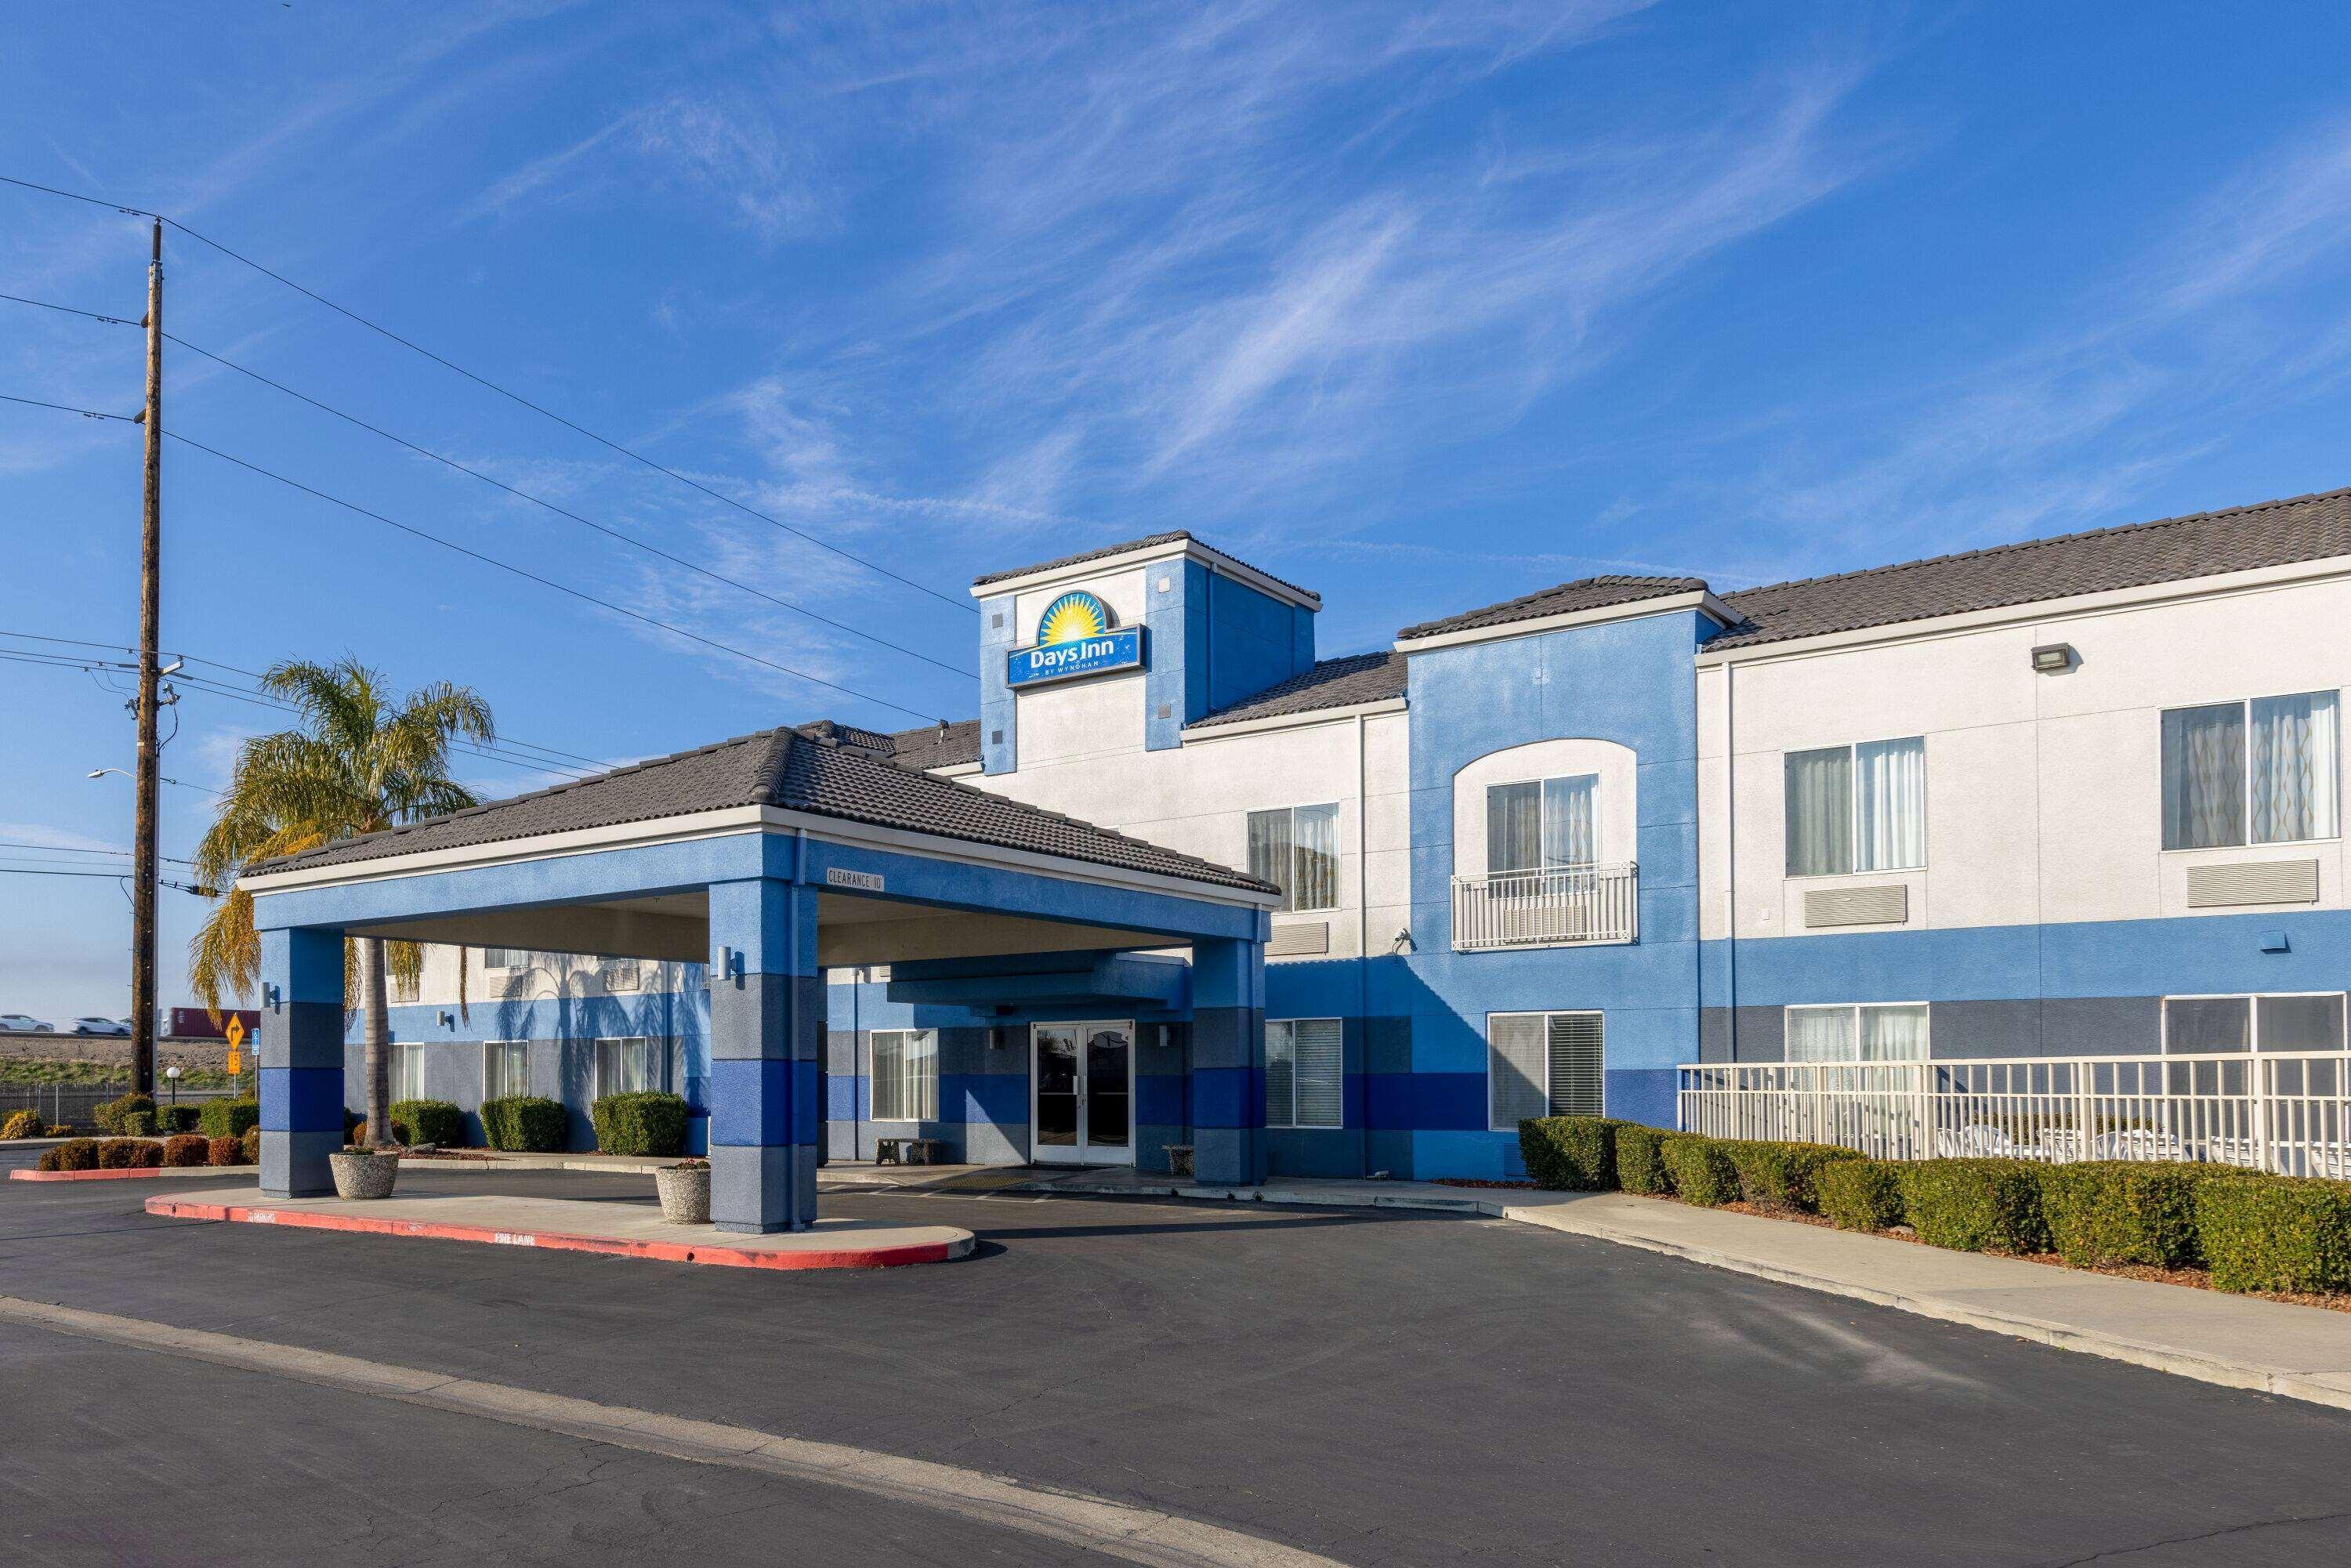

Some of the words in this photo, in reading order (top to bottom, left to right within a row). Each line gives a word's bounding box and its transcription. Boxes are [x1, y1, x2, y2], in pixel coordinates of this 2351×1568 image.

[1031, 647, 1078, 668] Days
[1080, 640, 1114, 661] Inn
[1057, 661, 1099, 673] WYNDHAM
[828, 870, 870, 887] CLEARANCE
